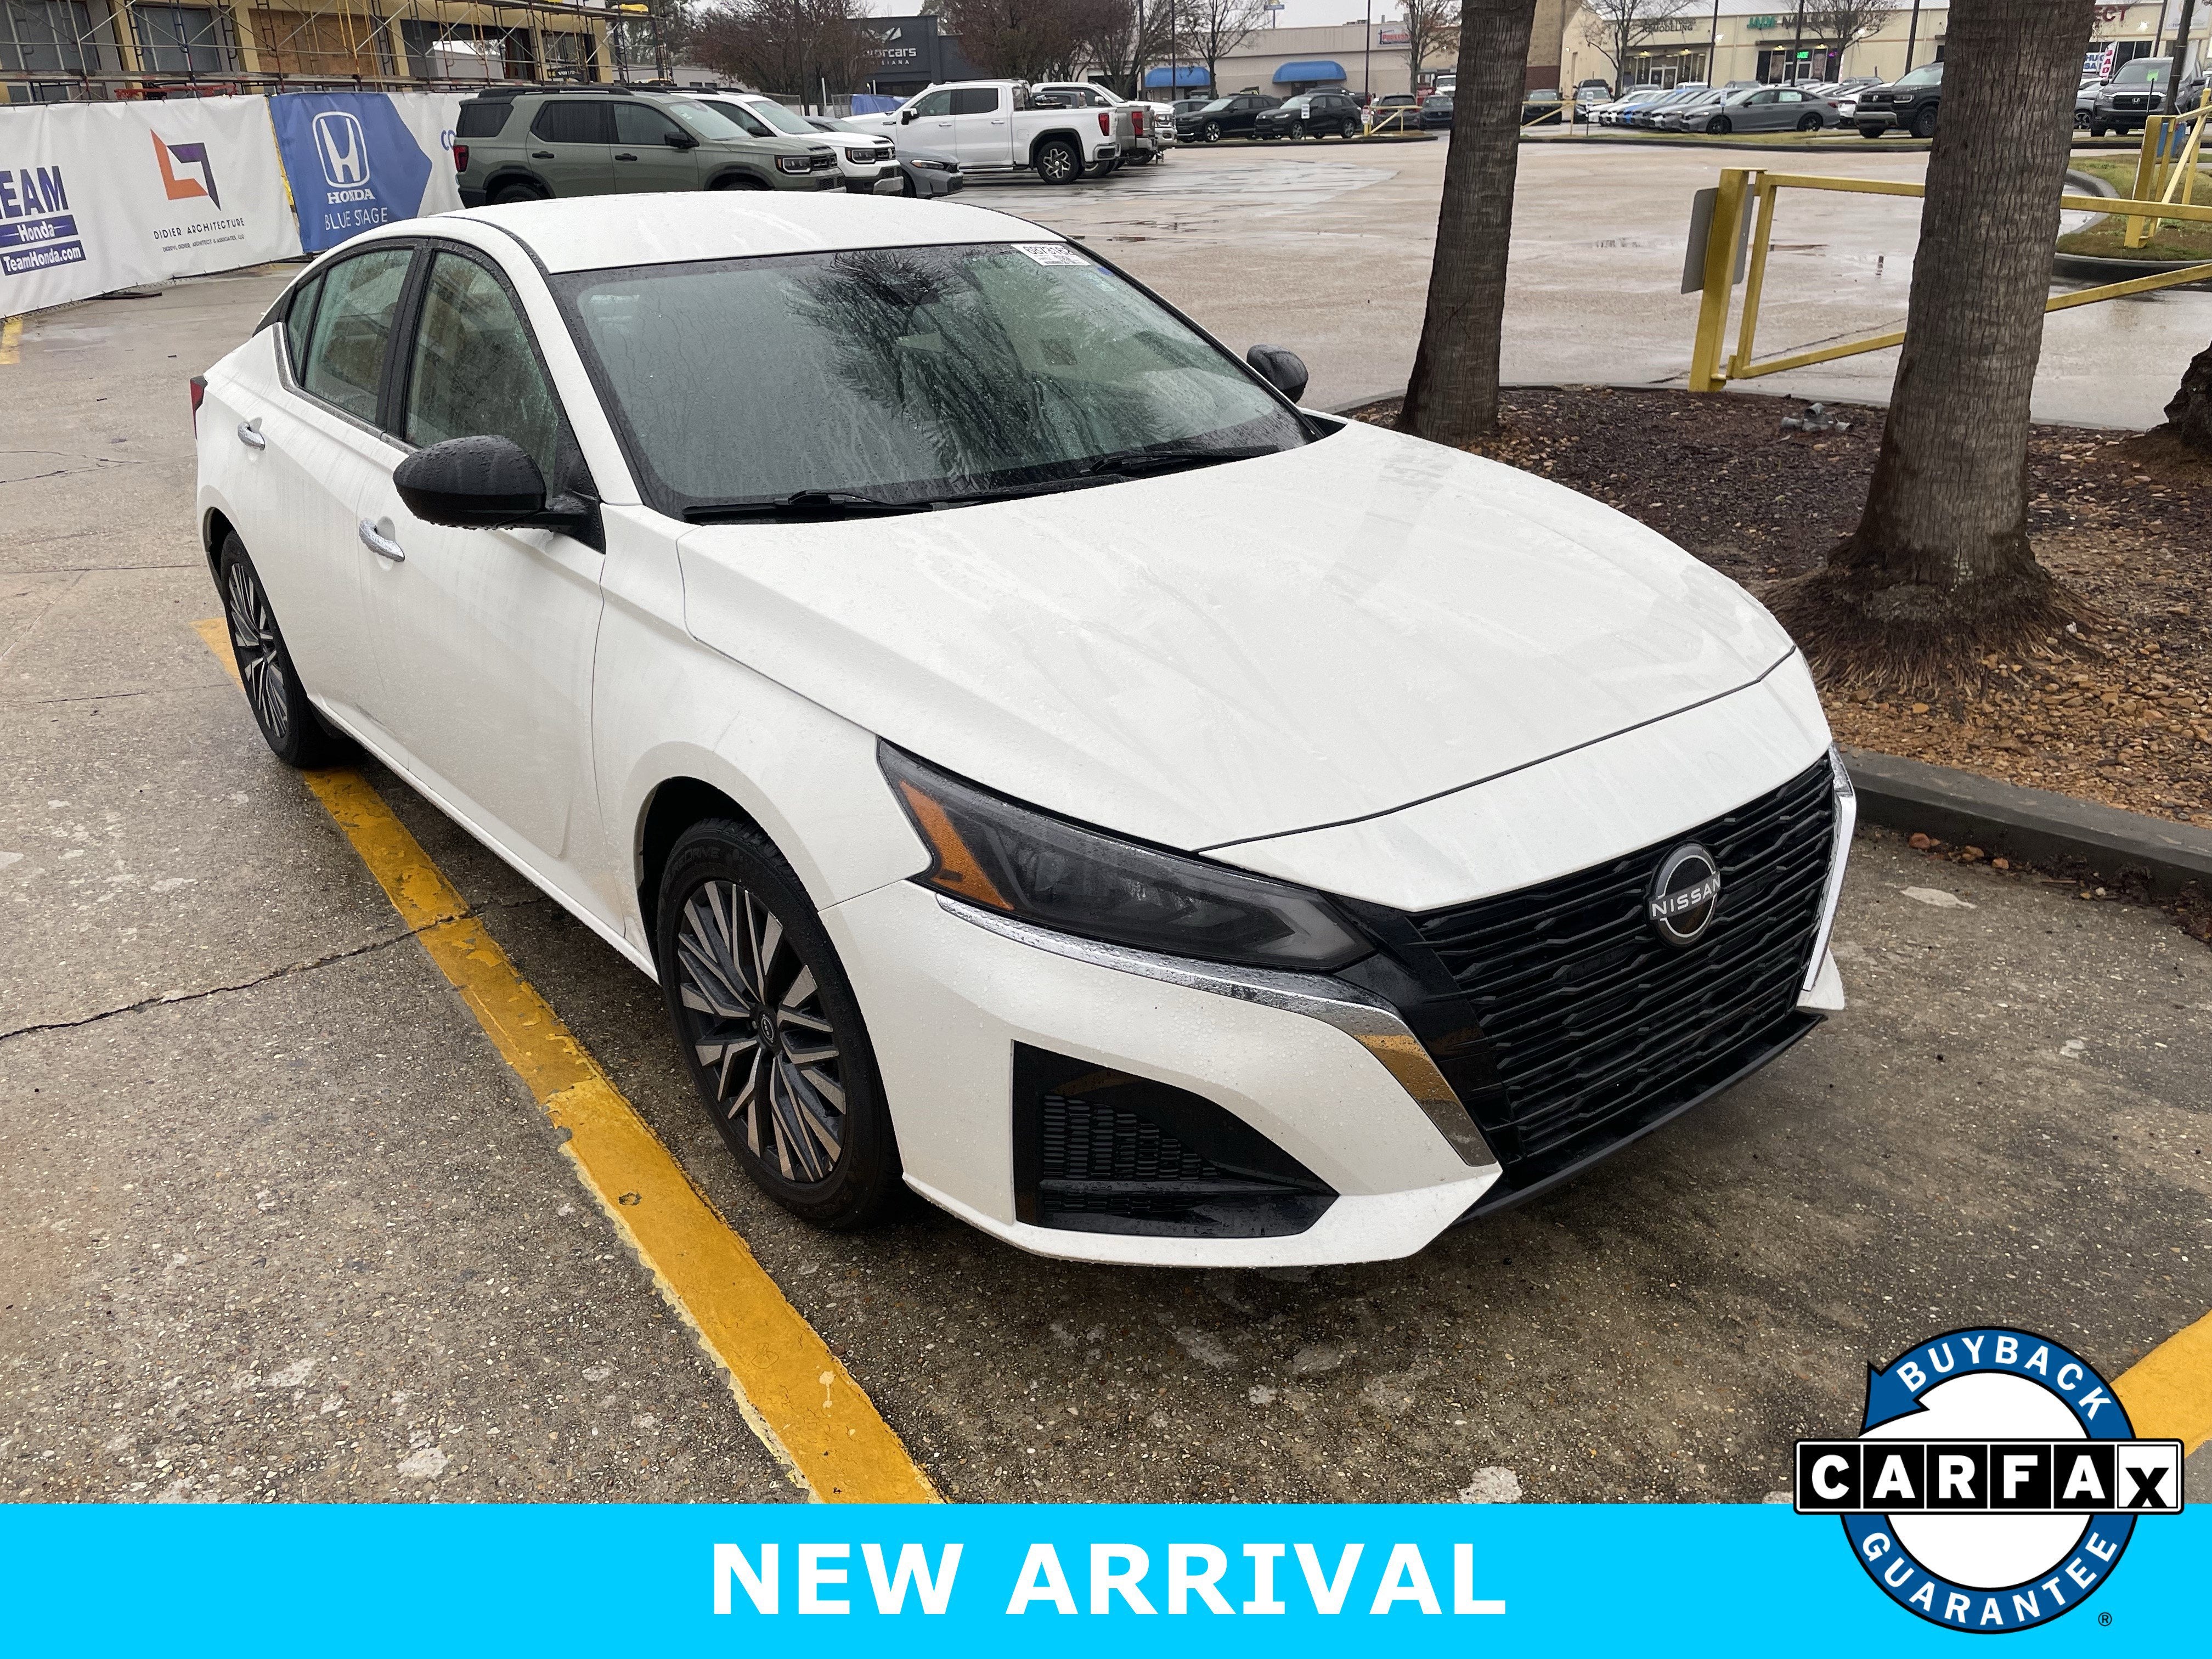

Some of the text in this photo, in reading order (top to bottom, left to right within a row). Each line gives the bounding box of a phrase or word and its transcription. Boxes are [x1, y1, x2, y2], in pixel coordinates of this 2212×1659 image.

[0, 166, 69, 219] EAM
[327, 189, 375, 204] HONDA
[154, 218, 245, 240] DIDIER ARCHITECTURE
[325, 207, 388, 230] BLUE STAGE
[17, 221, 55, 242] Honda
[193, 239, 212, 247] ARCHITECT
[3, 247, 81, 272] TeamHonda.com
[1652, 873, 1720, 917] NISSAN
